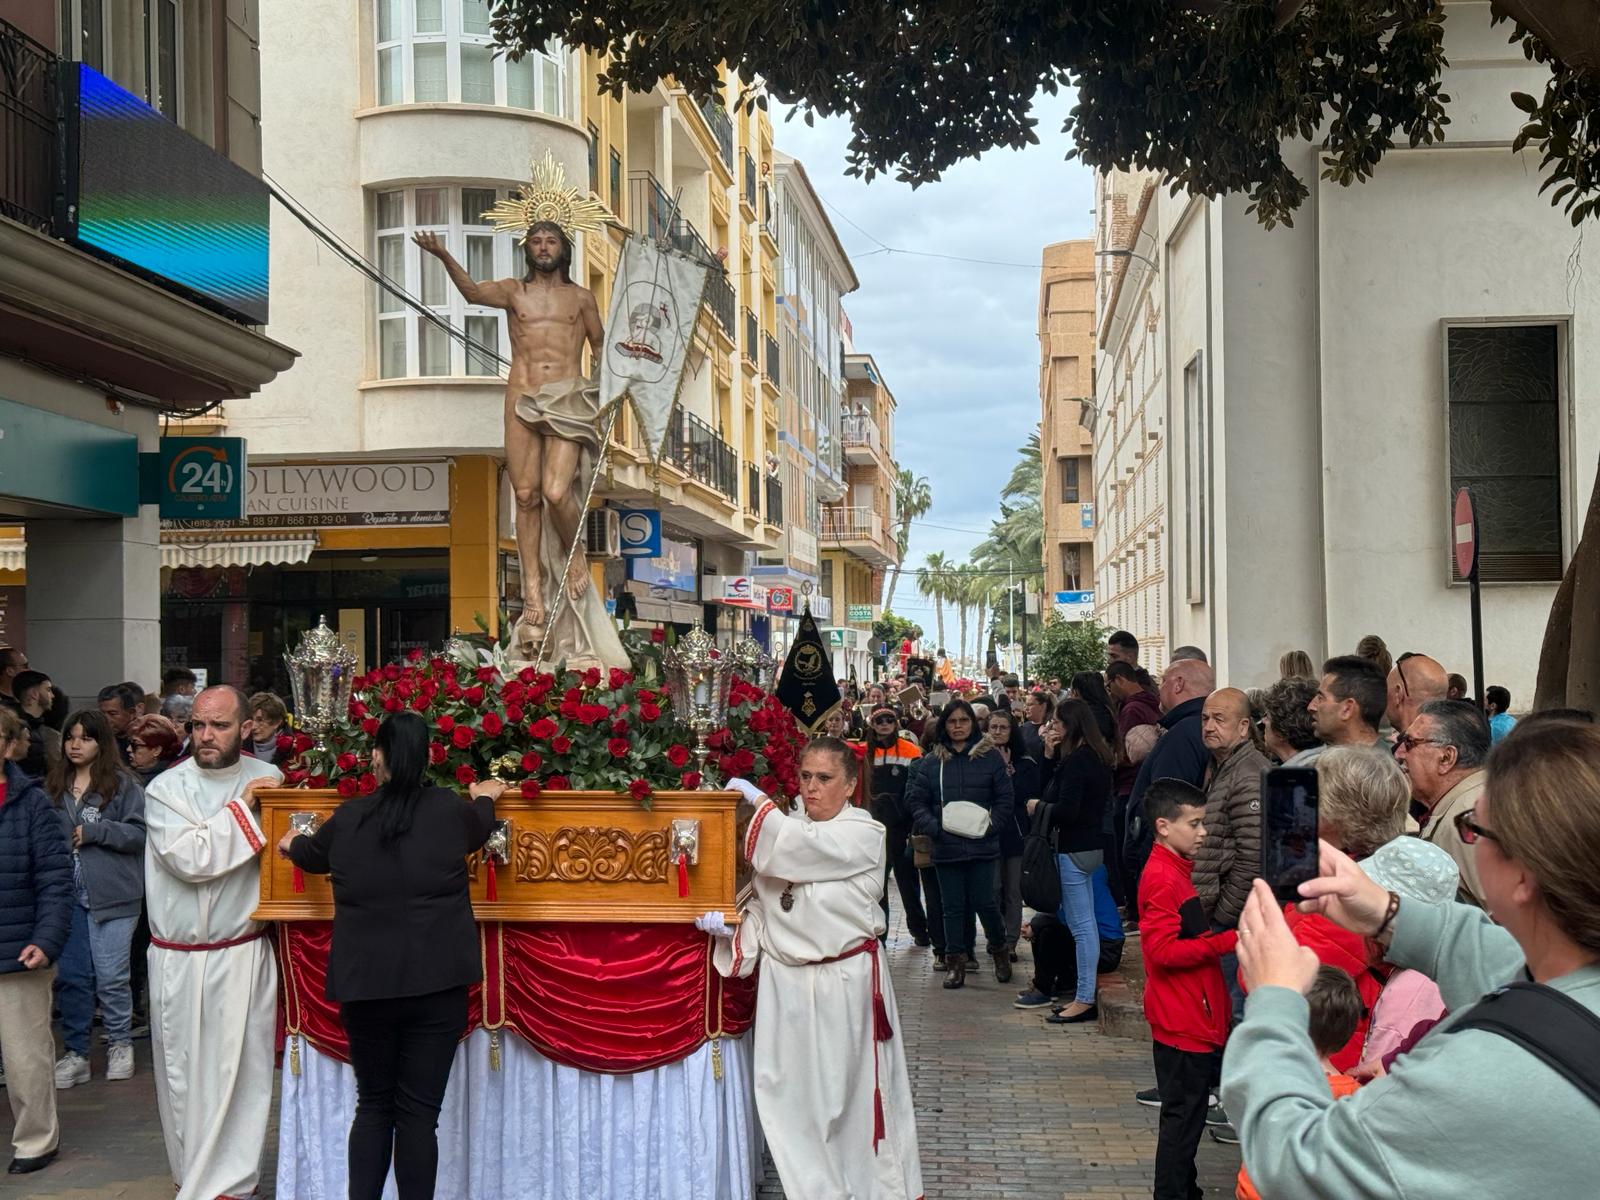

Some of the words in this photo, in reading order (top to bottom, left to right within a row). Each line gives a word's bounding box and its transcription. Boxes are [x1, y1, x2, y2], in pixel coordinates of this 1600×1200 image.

[277, 496, 349, 511] CUISINE
[252, 516, 265, 526] 88
[267, 516, 279, 526] 97
[307, 515, 319, 524] 78
[321, 515, 333, 524] 29
[335, 514, 347, 524] 04
[362, 511, 399, 525] Reparto
